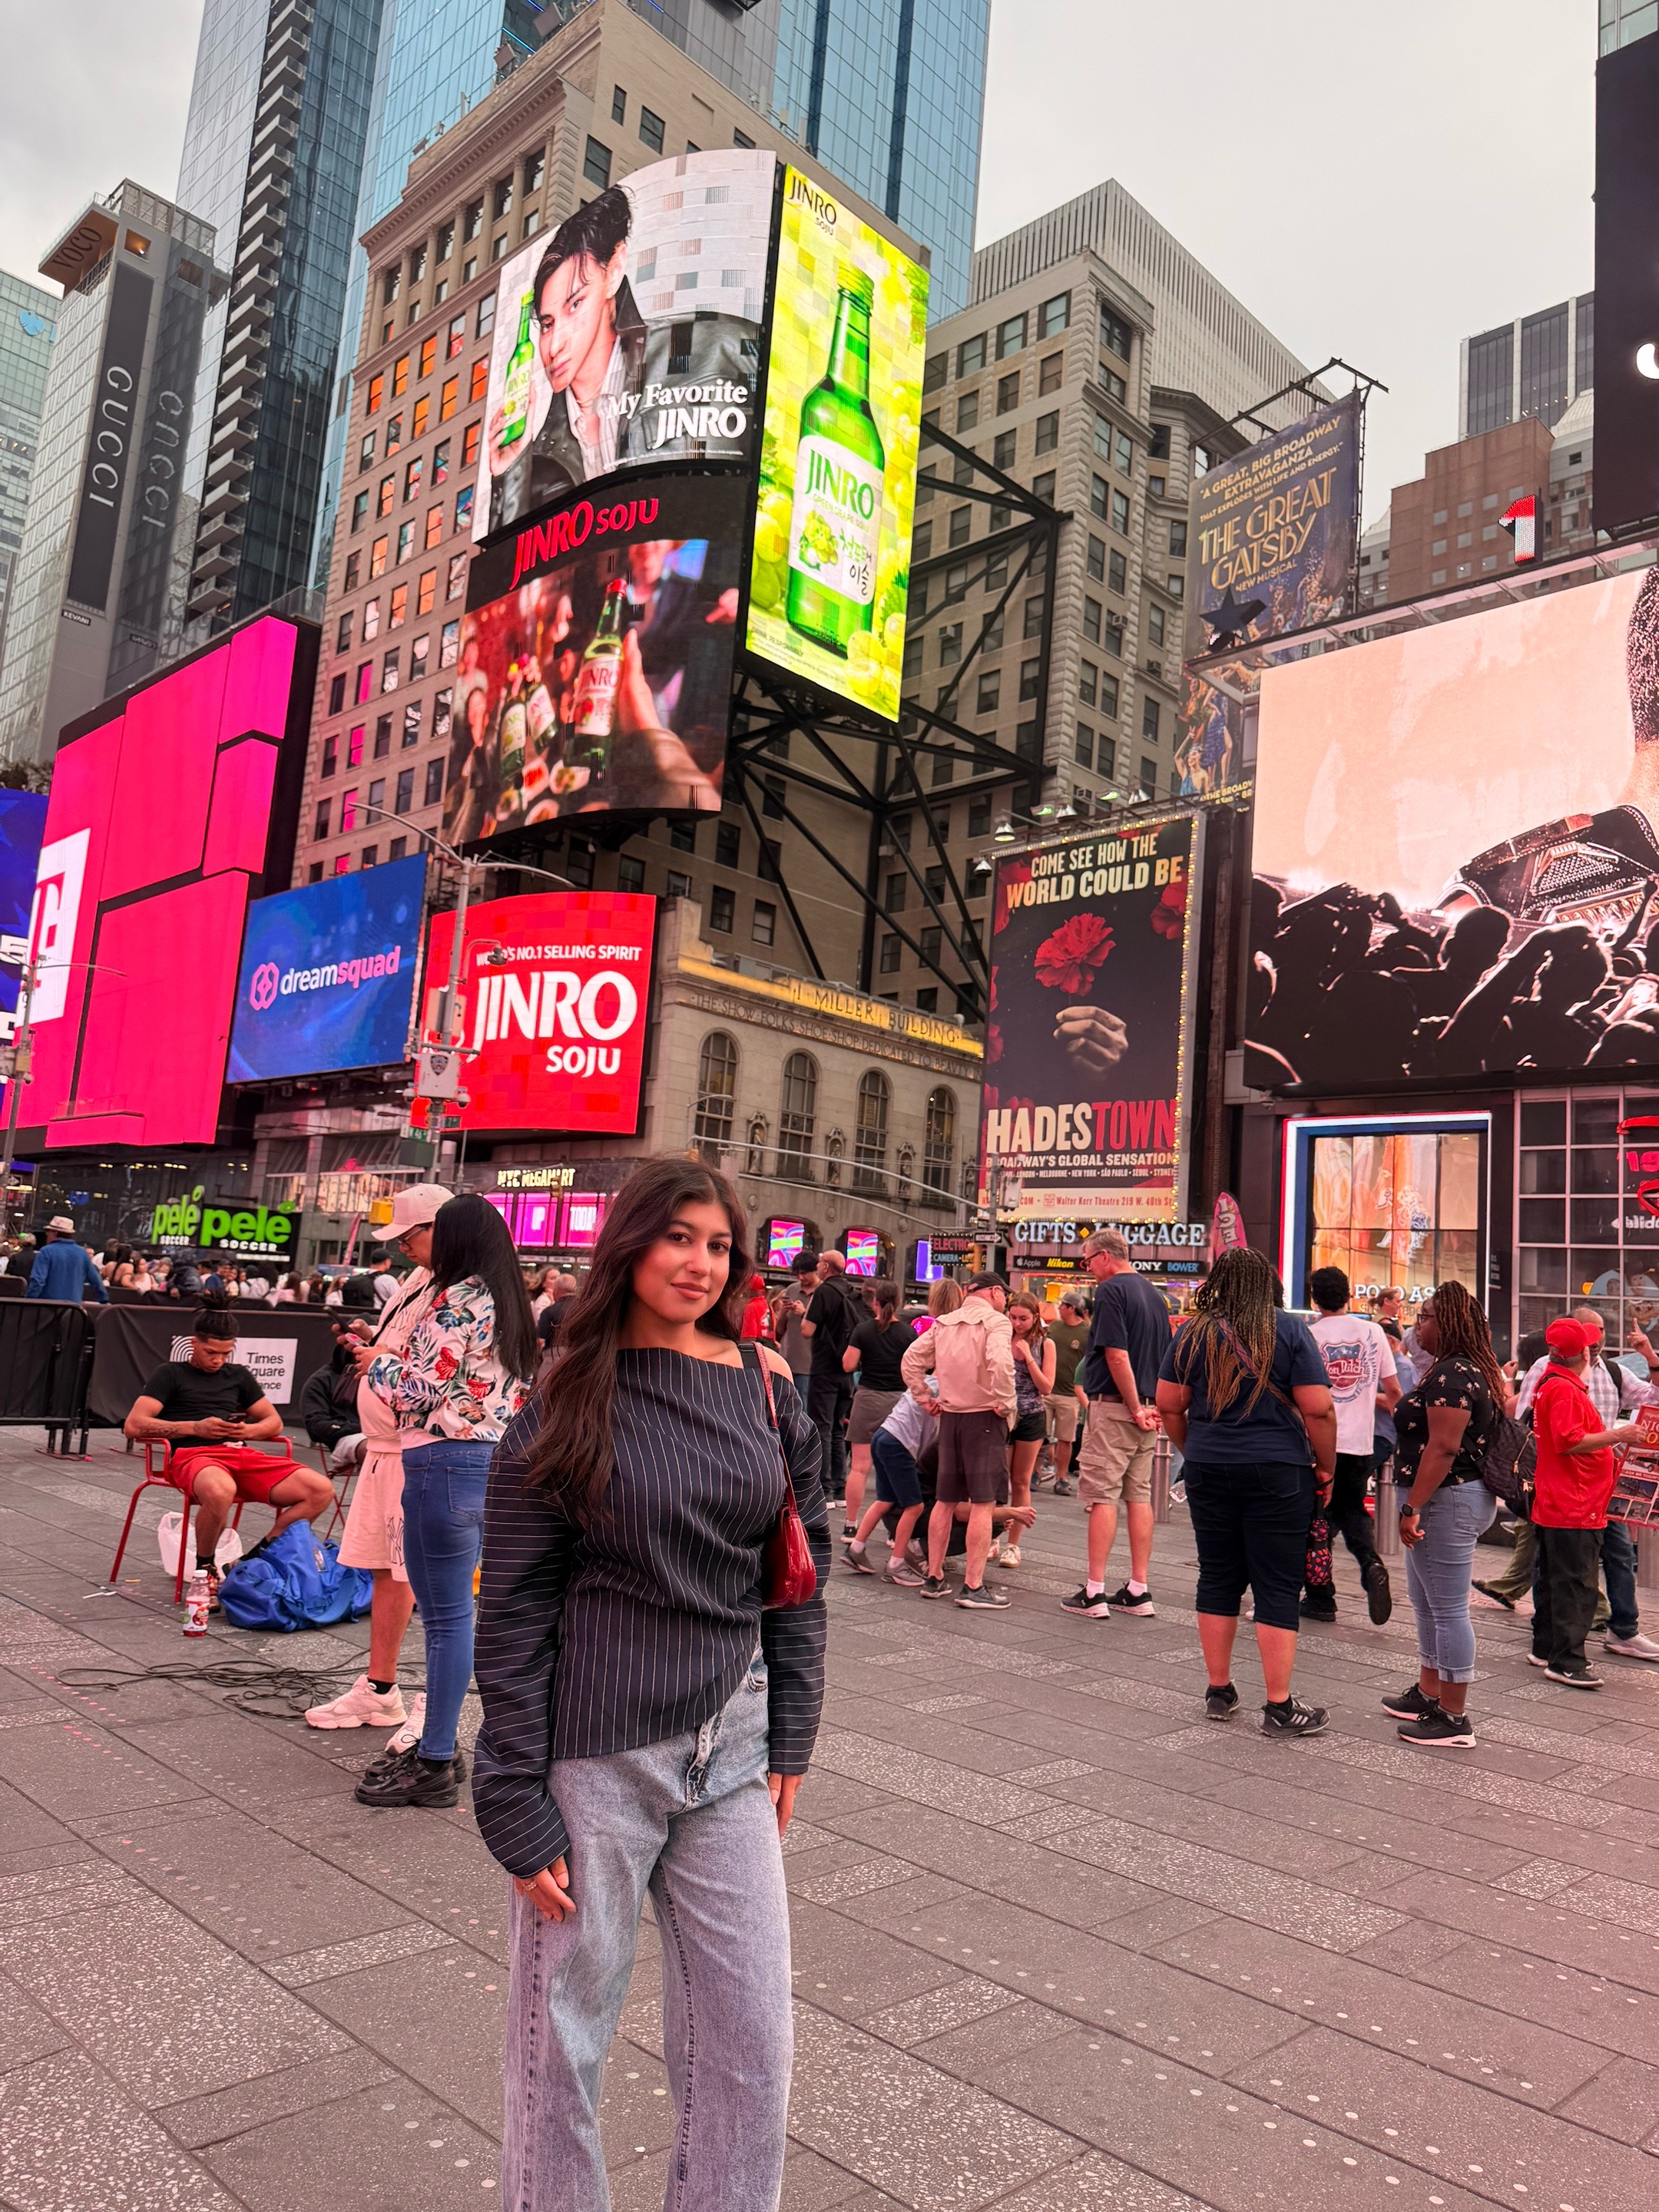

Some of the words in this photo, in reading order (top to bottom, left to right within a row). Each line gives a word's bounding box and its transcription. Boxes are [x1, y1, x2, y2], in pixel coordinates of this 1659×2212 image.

[789, 175, 836, 225] JINRO
[607, 390, 642, 419] My
[644, 378, 748, 409] Favorite
[89, 366, 133, 508] GUCCI
[652, 406, 747, 449] JINRO
[1251, 454, 1271, 472] BIG
[1273, 416, 1341, 460] BROADWAY
[805, 449, 875, 520] JINRO
[1200, 509, 1217, 522] THAT
[1217, 492, 1253, 514] EXPLODES
[1253, 480, 1273, 494] WITH
[1273, 471, 1290, 485] LIFE
[1290, 462, 1306, 476] AND
[1224, 446, 1313, 500] EXTRAVAGANZA
[1199, 516, 1241, 565] THE
[1246, 467, 1336, 538] GREAT
[1498, 495, 1538, 564] 1
[508, 501, 594, 591] JINRO
[595, 498, 659, 535] SOJU
[1211, 512, 1316, 591] GATSBY
[1236, 579, 1256, 592] NEW
[1257, 559, 1297, 584] MUSICAL
[1031, 851, 1066, 877] COME
[1069, 846, 1094, 870] SEE
[1098, 839, 1128, 866] HOW
[1131, 832, 1158, 858] THE
[1006, 875, 1075, 909] WORLD
[1079, 862, 1149, 898] COULD
[1154, 856, 1184, 886] BE
[280, 945, 401, 995] dreamsquad
[517, 946, 543, 961] NO.1
[544, 945, 596, 959] SELLING
[598, 945, 642, 960] SPIRIT
[466, 971, 638, 1064] JINRO
[695, 993, 717, 1010] THE
[721, 1000, 755, 1021] SHOW
[760, 1012, 795, 1031] FOLKS
[800, 1022, 827, 1038] SHOE
[831, 1031, 859, 1046] SHOP
[862, 1038, 914, 1062] DEDICATED
[918, 1055, 932, 1068] TO
[815, 990, 873, 1022] MILLER
[889, 1012, 956, 1043] BUILDING
[545, 1045, 621, 1078] SOJU
[987, 1099, 1177, 1154] HADESTOWN
[1039, 1169, 1068, 1177] MELBOURNE
[1132, 1168, 1148, 1177] SEOUL
[1153, 1168, 1174, 1177] SYDNEY
[1058, 1154, 1103, 1167] GLOBAL
[1106, 1152, 1174, 1166] SENSATION
[1056, 1197, 1075, 1205] Walter
[1078, 1197, 1091, 1205] Kerr
[1094, 1197, 1119, 1205] Theatre
[1121, 1197, 1134, 1205] 219
[160, 1235, 190, 1245] SOCCER
[219, 1239, 277, 1252] SOCCER
[1015, 1222, 1076, 1243] GIFTS
[933, 1253, 959, 1262] CAMERA
[1023, 1259, 1041, 1268] Apple
[1046, 1257, 1074, 1267] Nikon
[1130, 1260, 1163, 1271] ONY
[1167, 1262, 1199, 1272] BOWER
[1354, 1284, 1406, 1300] POO
[245, 1365, 285, 1379] quare
[247, 1352, 283, 1364] Times
